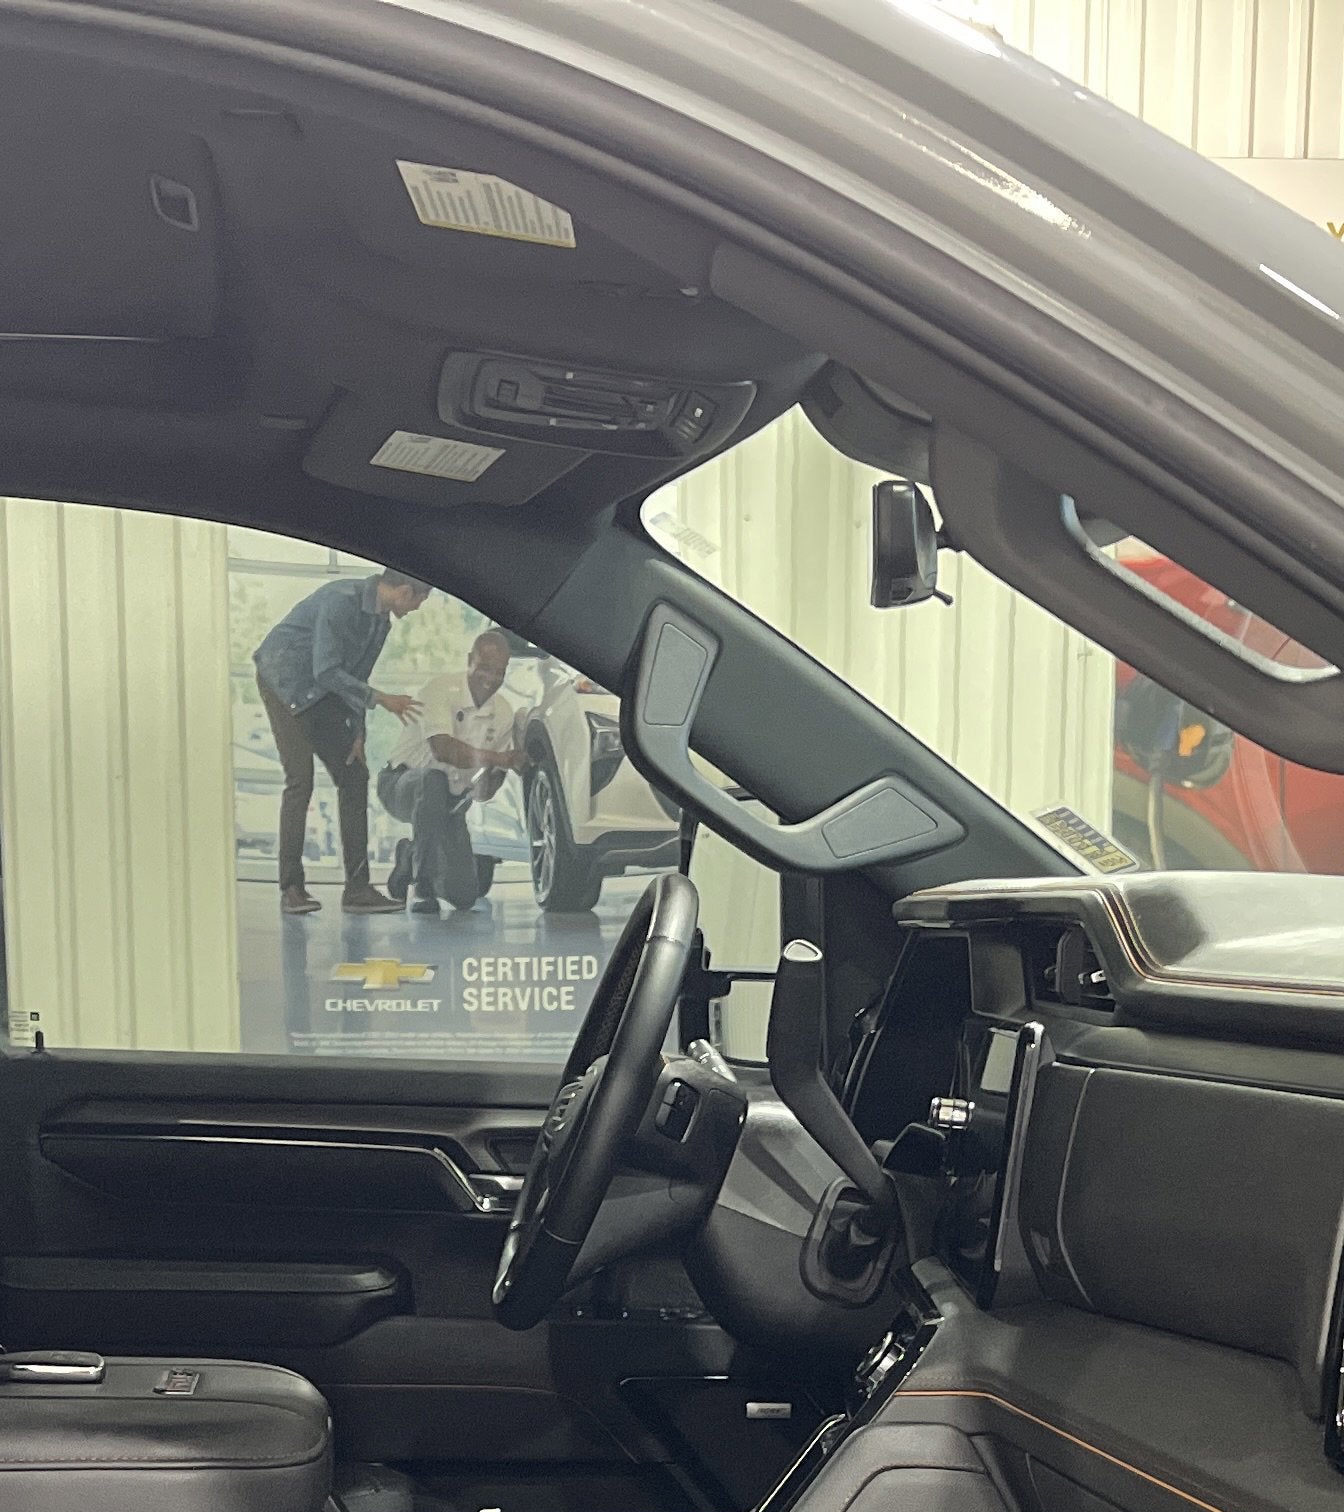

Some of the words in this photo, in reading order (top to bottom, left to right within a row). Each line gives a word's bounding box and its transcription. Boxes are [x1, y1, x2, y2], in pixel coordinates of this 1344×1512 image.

[462, 955, 598, 983] CERTIFIED
[324, 999, 442, 1012] CHEVROLET
[462, 986, 576, 1012] SERVICE
